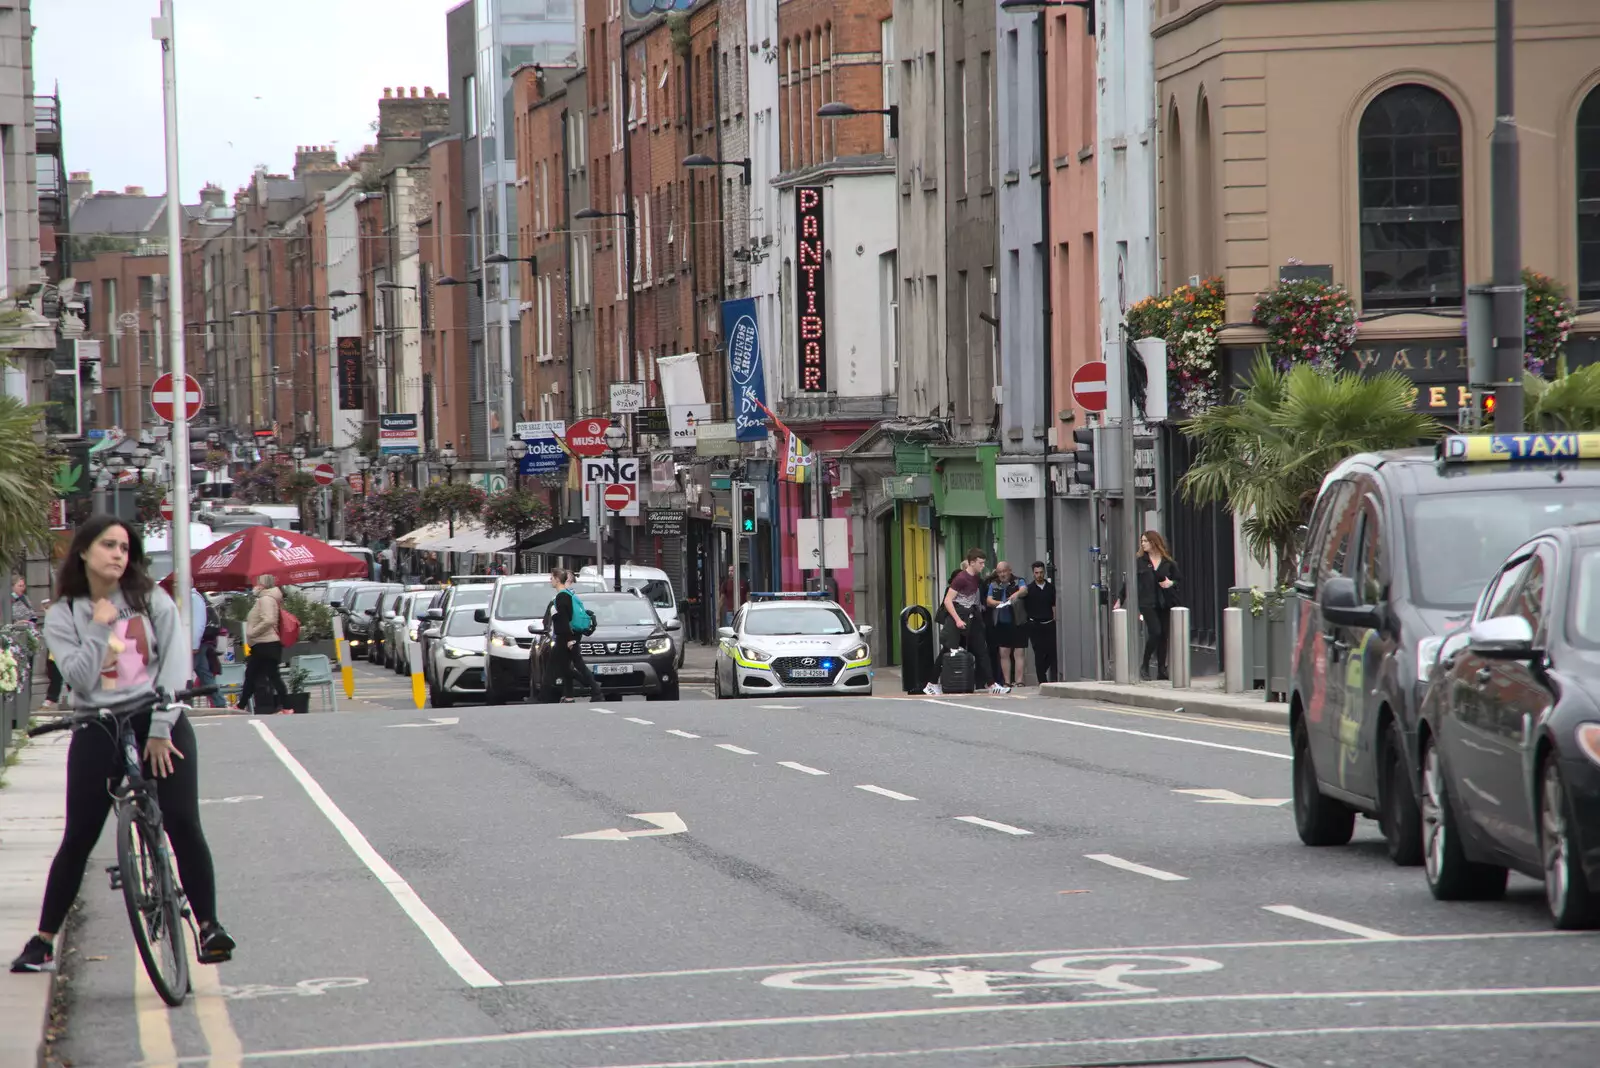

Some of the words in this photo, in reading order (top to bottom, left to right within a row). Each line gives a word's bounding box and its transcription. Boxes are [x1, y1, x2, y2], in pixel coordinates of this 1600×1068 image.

[800, 189, 823, 390] PANTIBAR
[732, 323, 747, 374] SOUNDS
[741, 326, 755, 378] AROUND
[612, 388, 641, 398] RUBBER
[616, 399, 638, 408] STAMP
[742, 398, 758, 414] DJ
[384, 418, 414, 426] Quantum
[526, 442, 563, 455] tokes
[1512, 435, 1577, 457] TAXI
[587, 463, 636, 482] DNG
[648, 511, 683, 521] Romano
